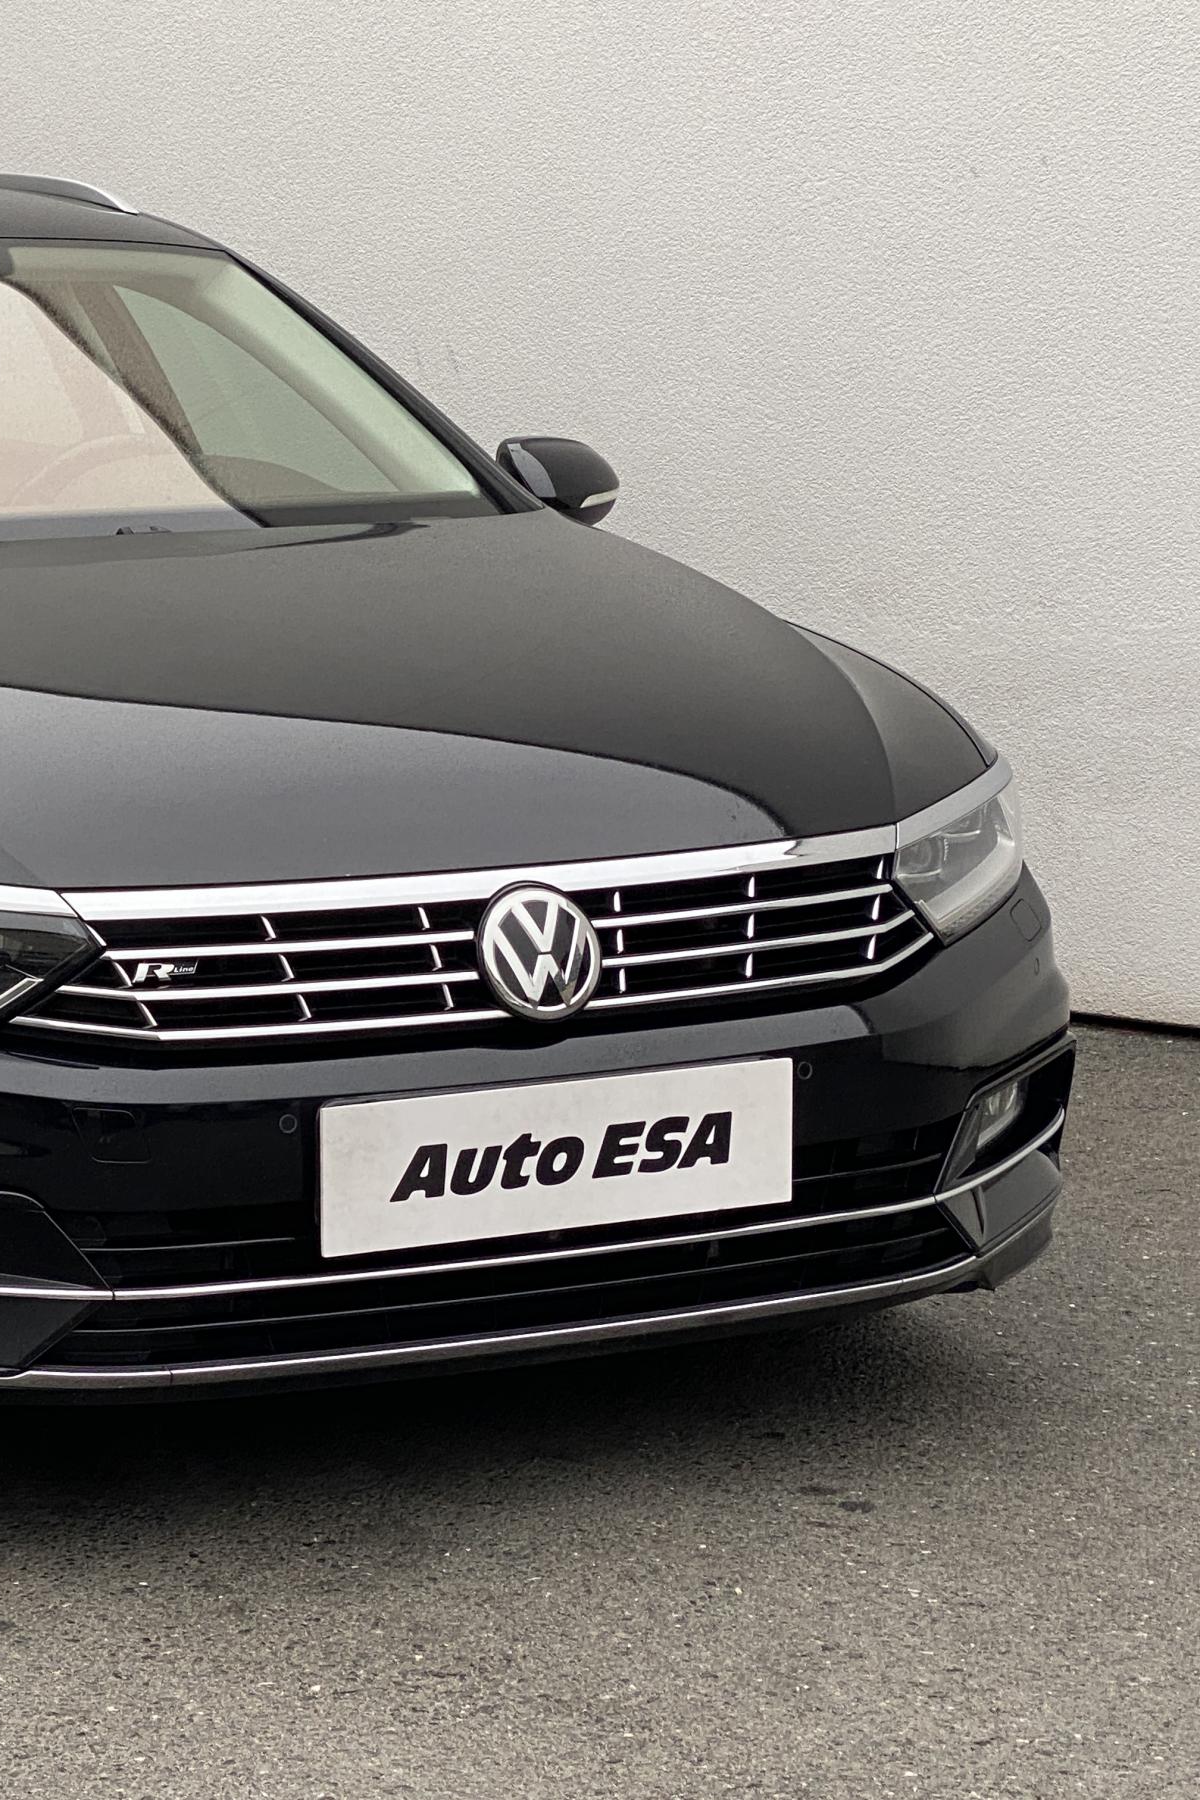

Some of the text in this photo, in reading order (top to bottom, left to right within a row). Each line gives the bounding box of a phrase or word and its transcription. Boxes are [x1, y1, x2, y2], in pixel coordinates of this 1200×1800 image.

[132, 962, 174, 983] R
[488, 892, 592, 1012] VW
[389, 1111, 732, 1203] Auto ESA
